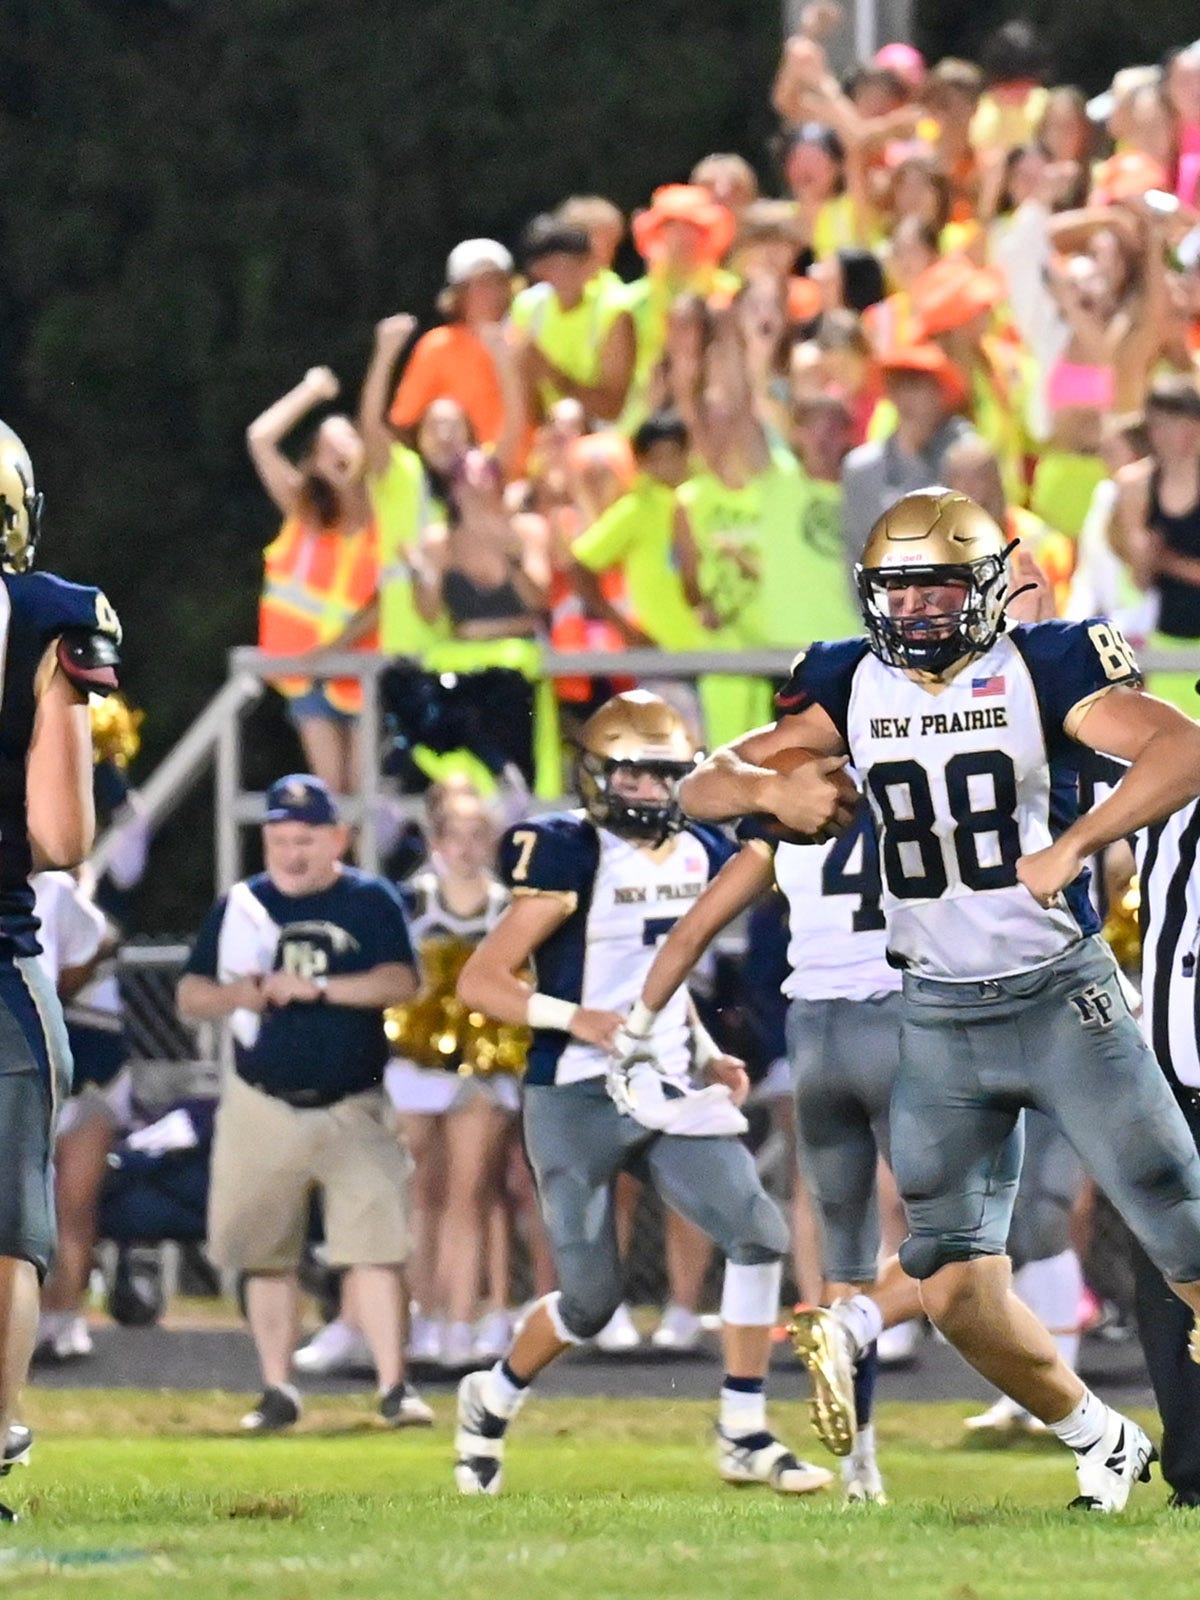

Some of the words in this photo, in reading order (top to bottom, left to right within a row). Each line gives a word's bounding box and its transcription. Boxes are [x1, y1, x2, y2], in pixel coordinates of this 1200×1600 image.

[870, 718, 911, 738] NEW
[921, 707, 1008, 736] PRAIRIE
[512, 830, 538, 880] 7
[822, 783, 887, 932] 4
[868, 750, 1022, 899] 88
